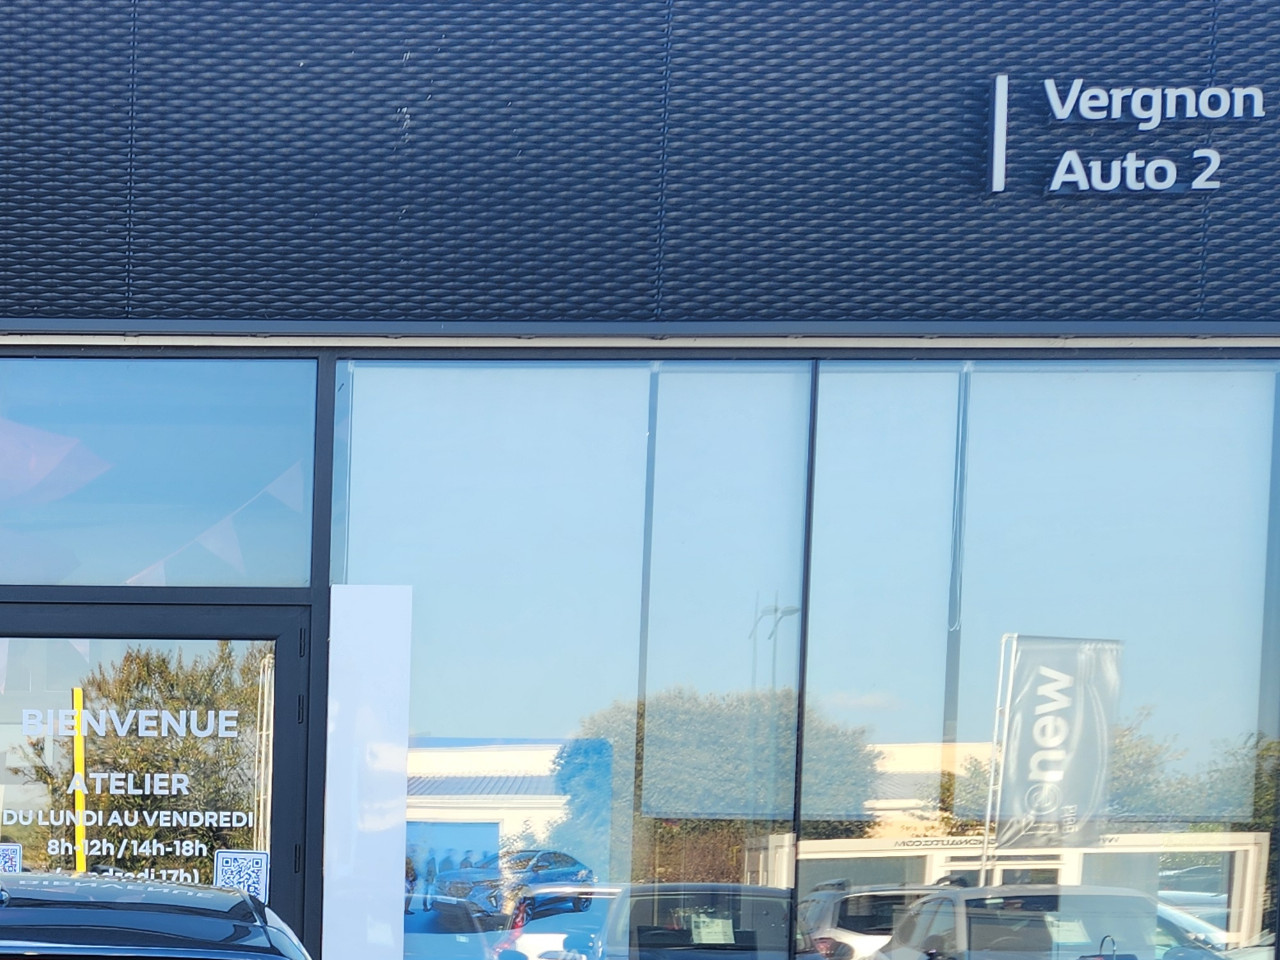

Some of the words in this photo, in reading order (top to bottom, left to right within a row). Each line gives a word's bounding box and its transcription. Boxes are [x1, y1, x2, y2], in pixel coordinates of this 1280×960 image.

[1043, 78, 1266, 131] Vergnon
[1049, 150, 1177, 191] Auto
[1191, 149, 1221, 189] 2
[21, 709, 240, 738] BIENVENUE
[66, 772, 190, 795] ATELIER
[2, 810, 33, 827] DU
[38, 810, 103, 827] LUNDI
[107, 811, 139, 827] AU
[142, 811, 254, 828] VENDREDI
[47, 838, 115, 857] 8h-12h
[131, 838, 208, 857] 14h-18h
